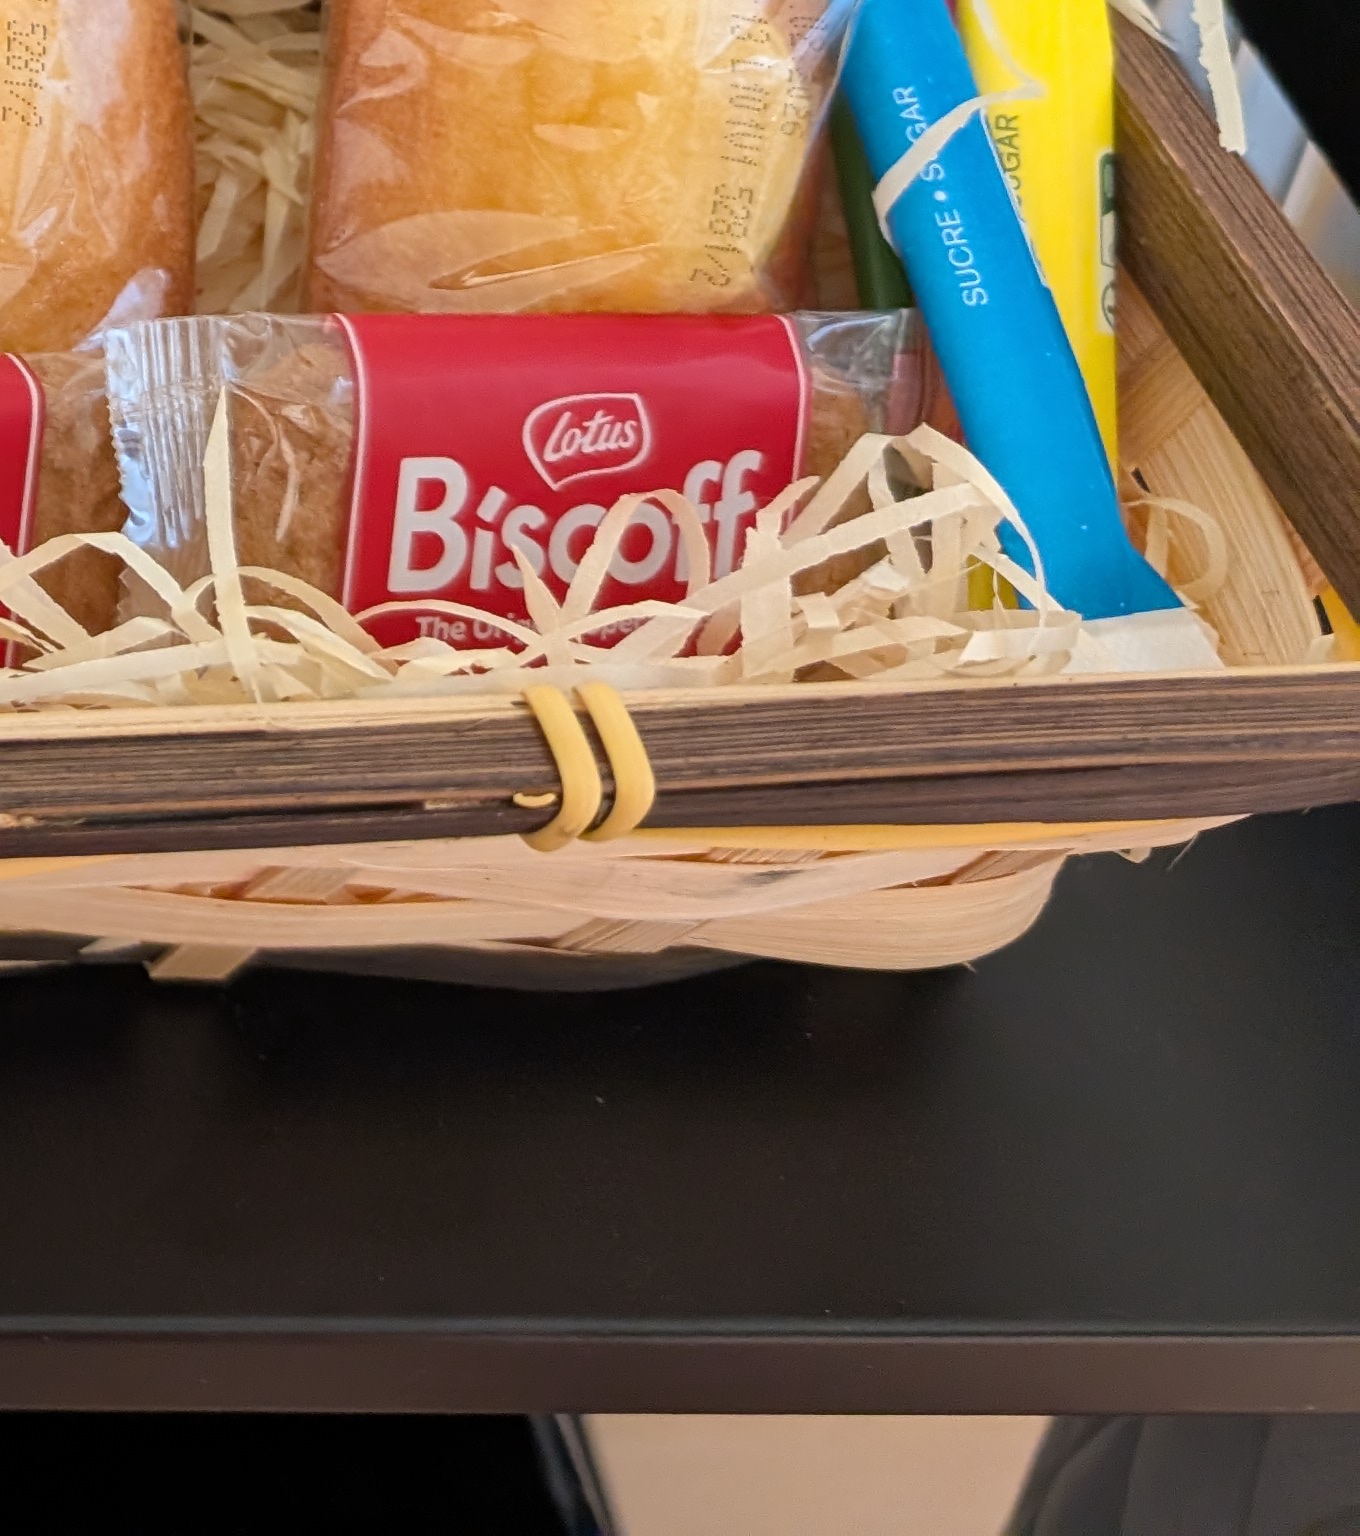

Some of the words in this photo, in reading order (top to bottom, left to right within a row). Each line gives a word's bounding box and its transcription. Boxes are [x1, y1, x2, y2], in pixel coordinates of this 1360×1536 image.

[893, 85, 945, 182] SGAR
[994, 114, 1022, 199] UGAR
[935, 208, 989, 306] SUCRE
[387, 450, 762, 593] Biscoff
[416, 616, 467, 640] The
